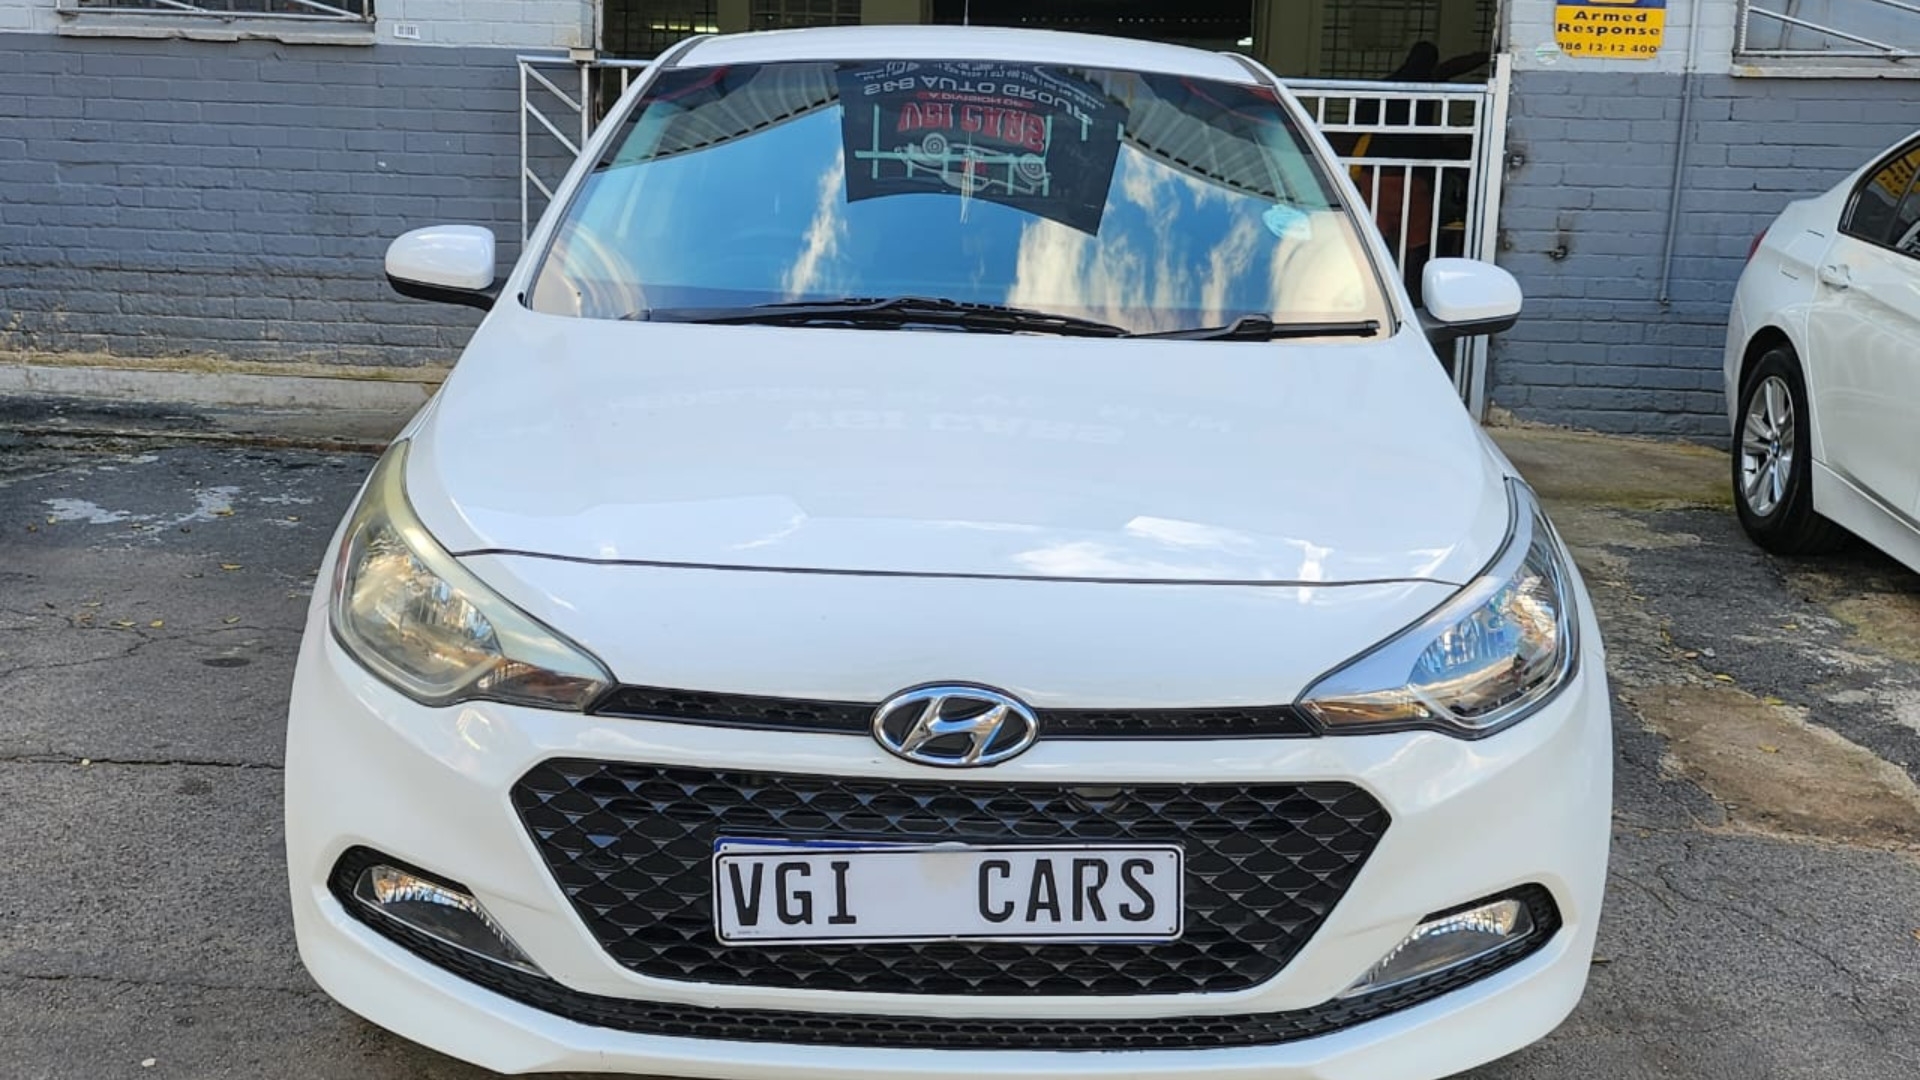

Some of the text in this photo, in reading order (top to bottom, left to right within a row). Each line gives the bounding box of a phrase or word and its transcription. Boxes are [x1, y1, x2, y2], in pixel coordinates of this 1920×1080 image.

[1574, 10, 1647, 22] Armed
[1557, 23, 1660, 36] Response
[729, 858, 1155, 926] VGI CARS
